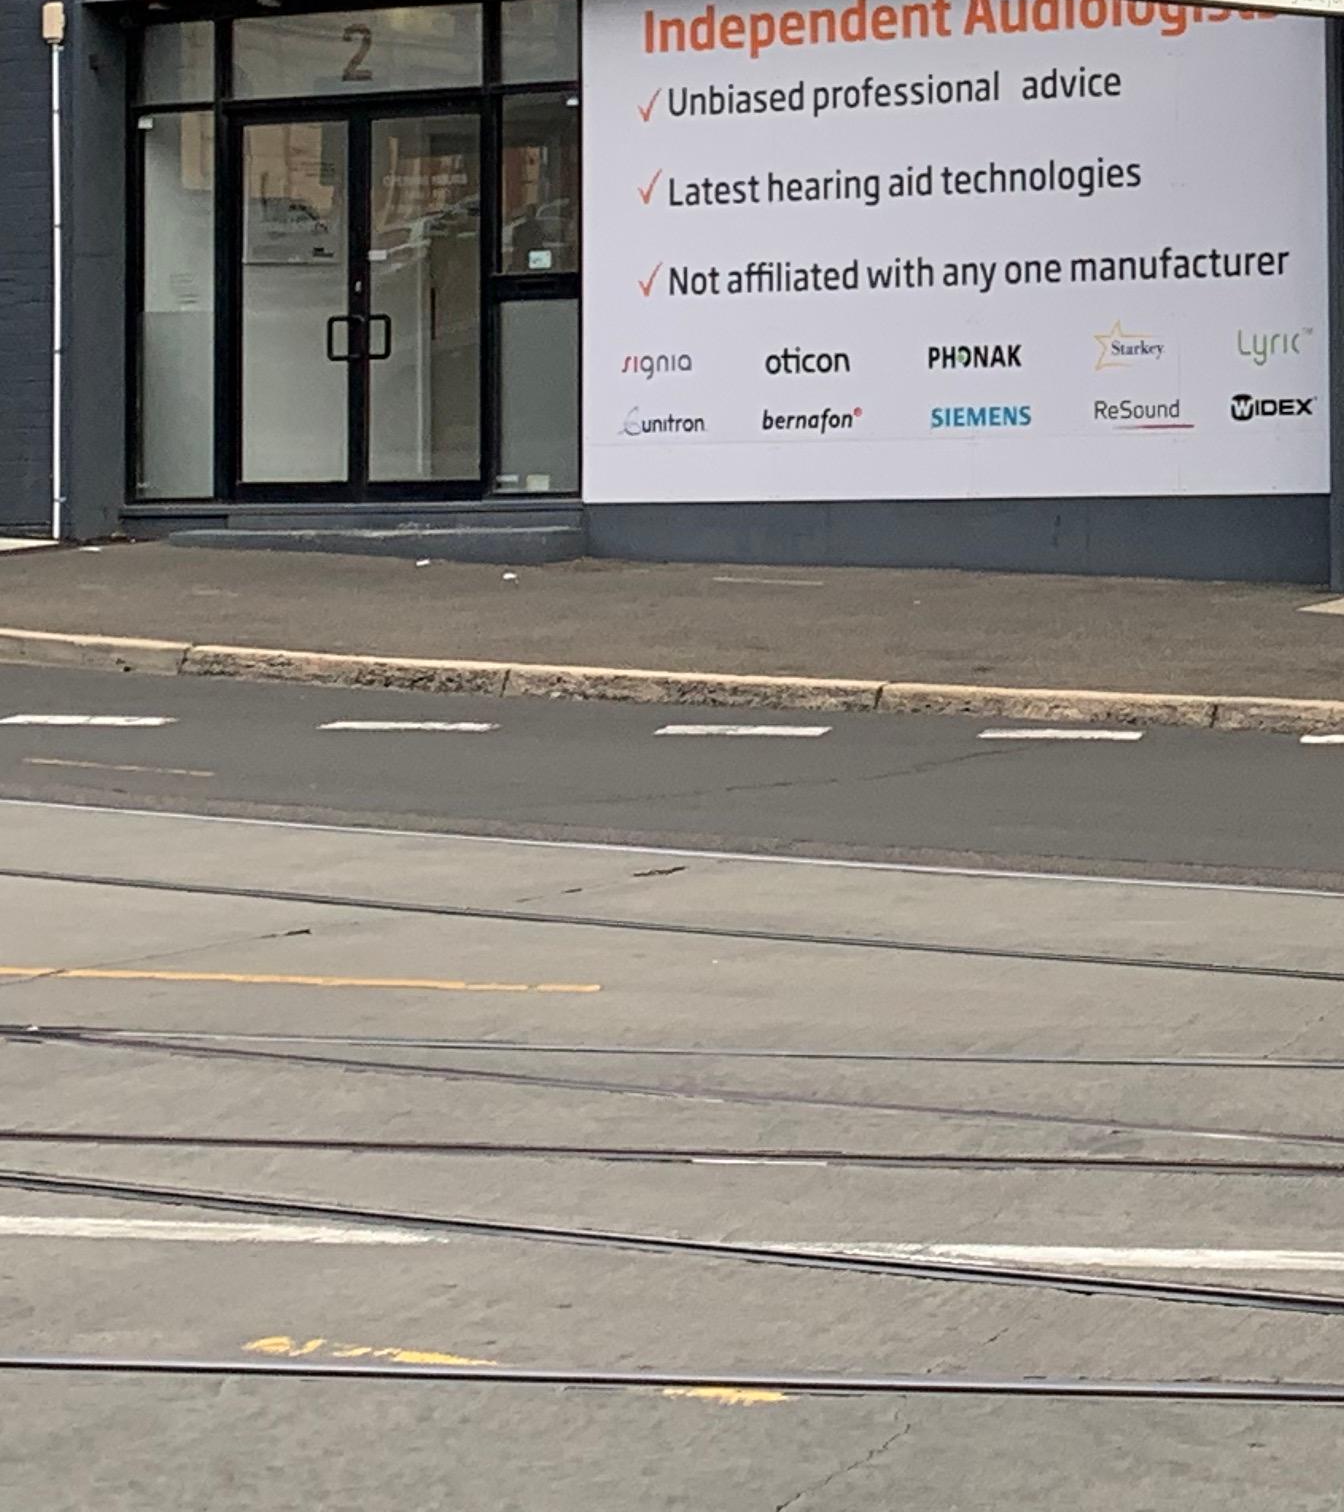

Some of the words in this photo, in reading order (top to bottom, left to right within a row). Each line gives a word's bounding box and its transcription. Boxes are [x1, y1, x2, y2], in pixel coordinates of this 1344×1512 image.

[342, 24, 373, 81] 2
[667, 79, 806, 117] Unbiased
[812, 71, 1000, 116] professional
[1021, 67, 1122, 103] advice
[668, 172, 760, 207] Latest
[767, 168, 881, 208] hearing
[887, 165, 934, 199] aid
[941, 157, 1142, 197] technologies
[668, 266, 720, 297] Not
[726, 260, 860, 295] affiliated
[866, 257, 936, 291] with
[941, 260, 996, 293] any
[1004, 257, 1063, 286] one
[1070, 247, 1290, 284] manufacturer
[765, 346, 850, 374] oticon
[928, 343, 1023, 369] PHONAK
[1110, 340, 1164, 360] Starkey
[621, 354, 693, 381] signia
[931, 406, 1032, 429] SIEMENS
[1093, 399, 1181, 420] ReSound
[1231, 394, 1314, 421] WIDEX
[762, 409, 854, 434] bernafon
